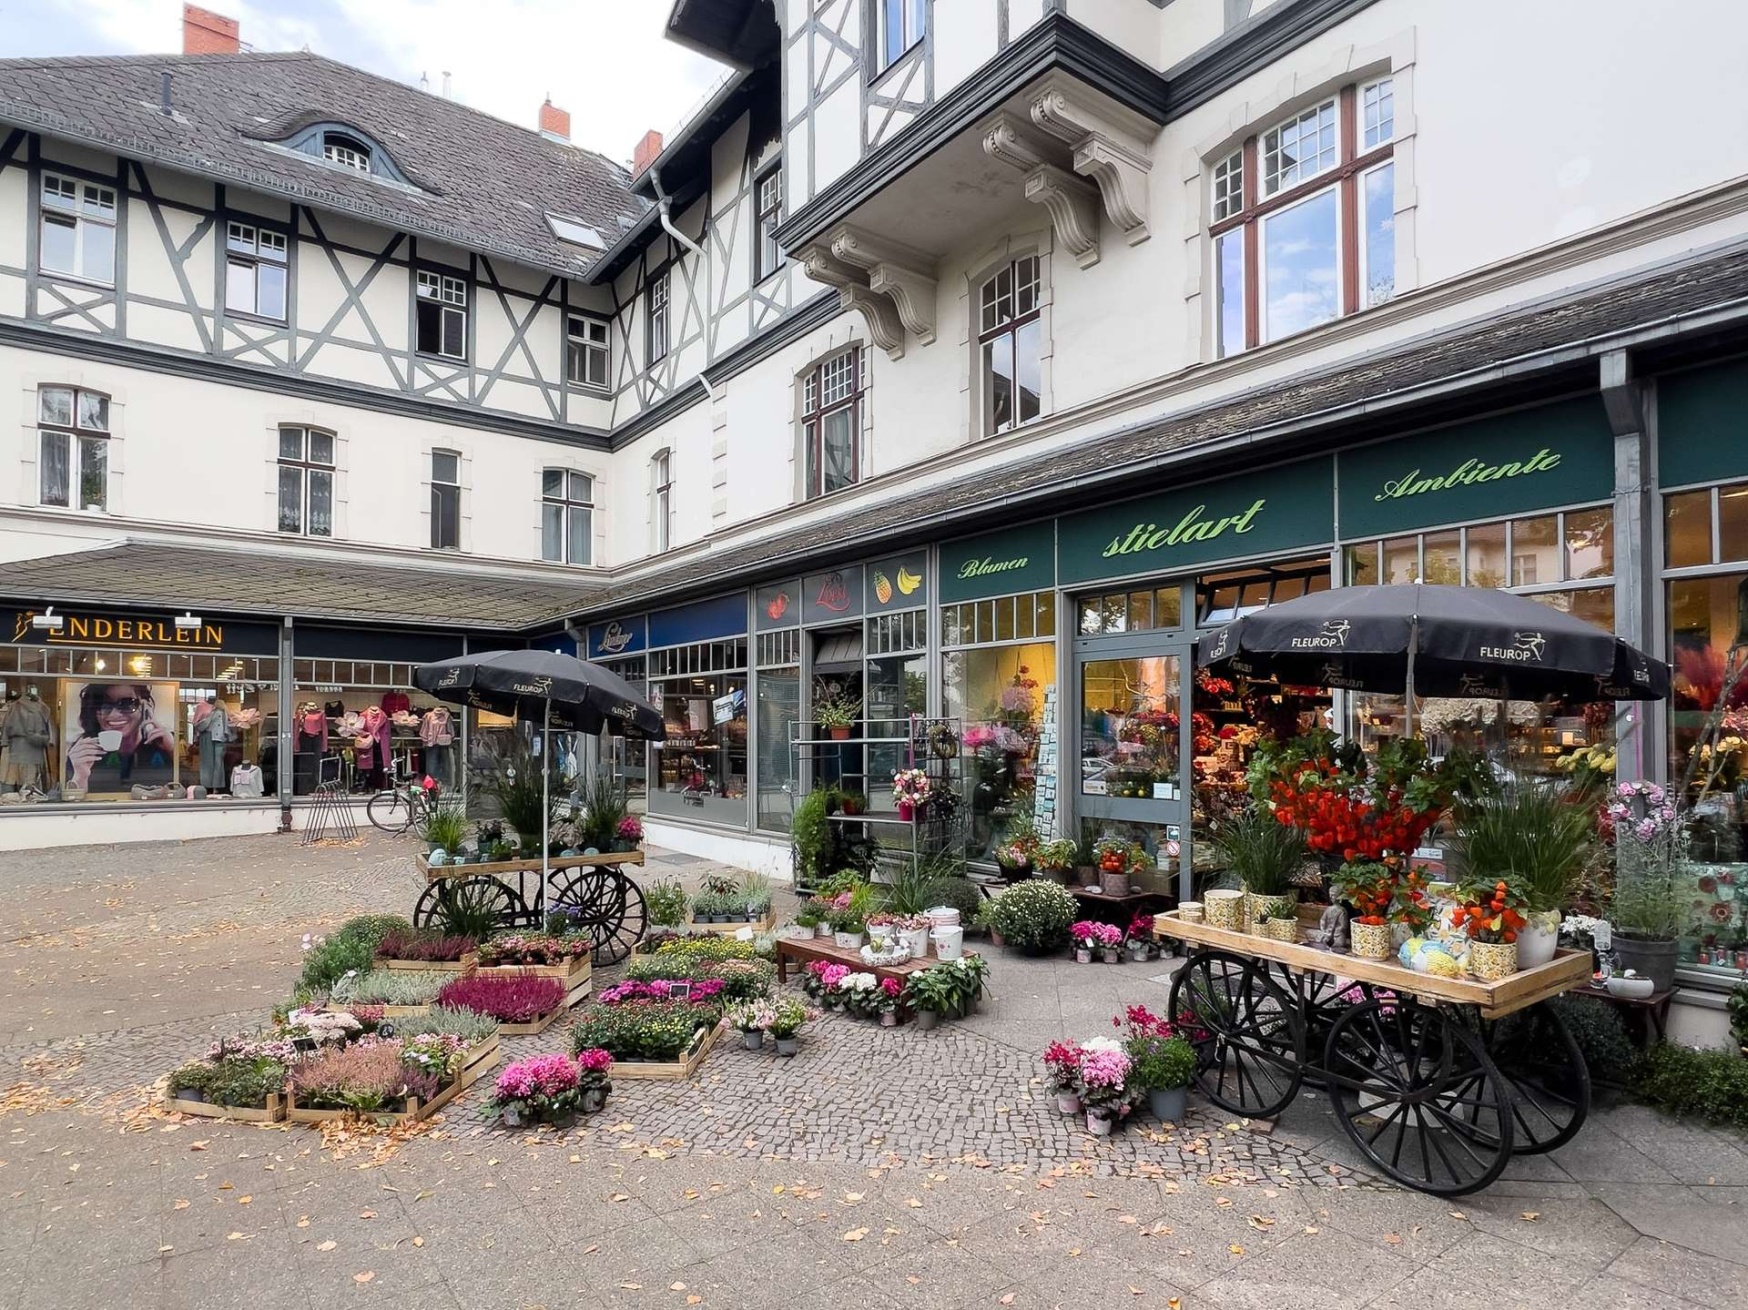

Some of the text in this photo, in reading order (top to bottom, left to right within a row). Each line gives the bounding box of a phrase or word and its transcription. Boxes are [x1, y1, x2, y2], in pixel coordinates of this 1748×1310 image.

[1375, 448, 1561, 501] Ambiente
[1102, 499, 1266, 557] stielart
[957, 556, 1028, 579] Blumen
[1291, 637, 1338, 648] FLEUROP
[1480, 646, 1531, 661] FLEUROP
[513, 683, 543, 694] FLEUROP
